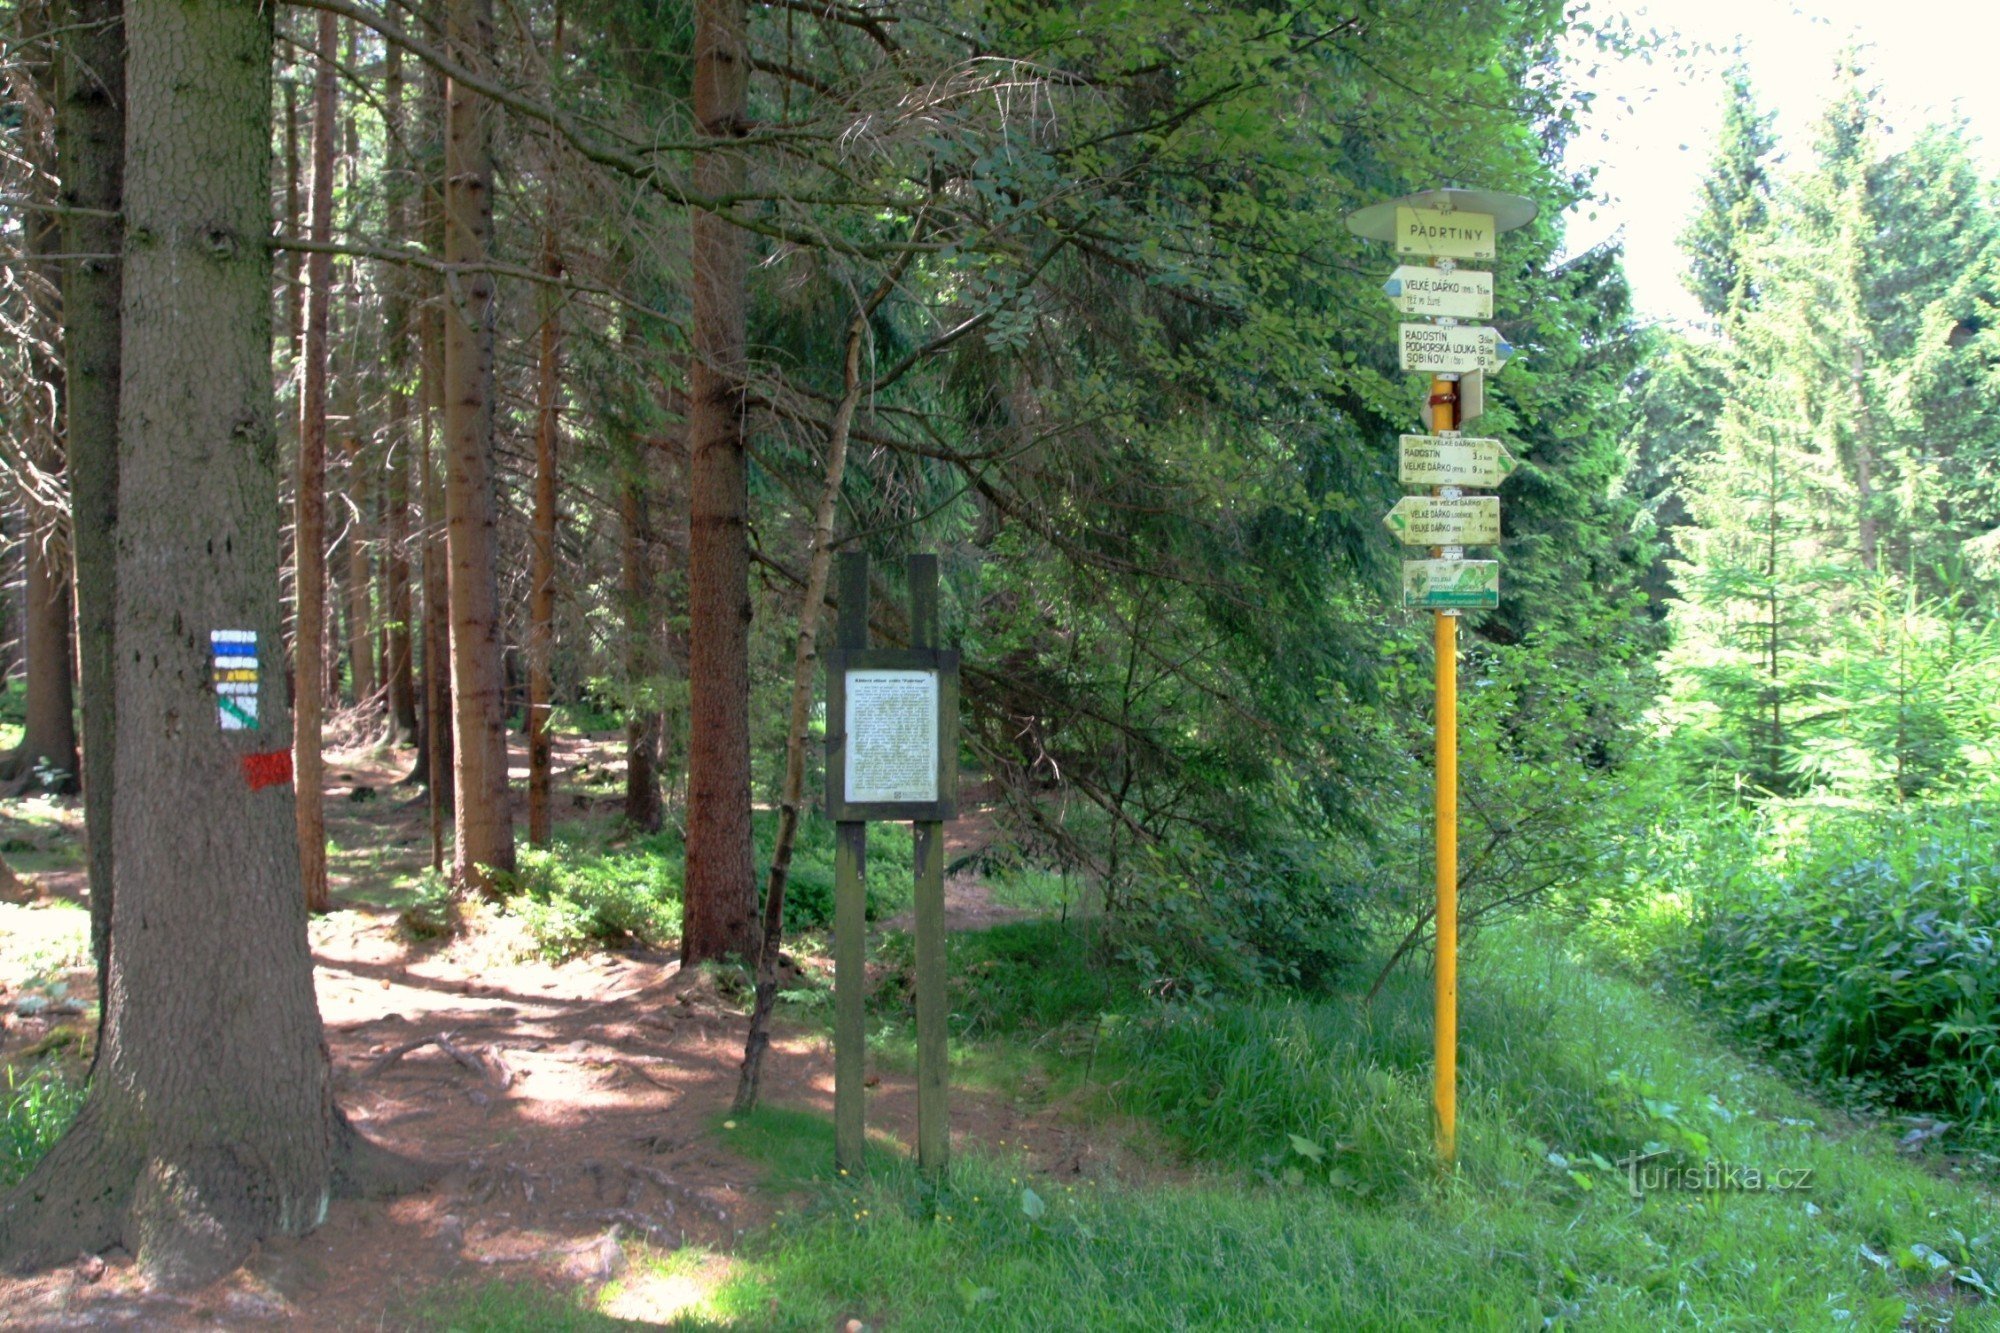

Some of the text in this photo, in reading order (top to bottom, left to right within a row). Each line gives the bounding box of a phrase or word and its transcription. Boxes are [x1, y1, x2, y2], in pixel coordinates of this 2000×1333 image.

[1410, 224, 1483, 241] PADRTINY
[1405, 278, 1429, 291] VELKÉ
[1432, 279, 1460, 293] DÁŘKO
[1405, 329, 1447, 341] RADOSTÍN
[1405, 342, 1451, 353] PODHORSKÁ
[1453, 344, 1477, 354] LOUKA
[1477, 356, 1485, 365] 18
[1404, 462, 1426, 470] VELKÉ
[1427, 463, 1451, 472] DÁŘKO
[1410, 509, 1429, 518] VELKÉ
[1430, 509, 1451, 518] DÁŘKO
[1410, 523, 1429, 532] VELKÉ
[1430, 522, 1451, 532] DÁŘKO
